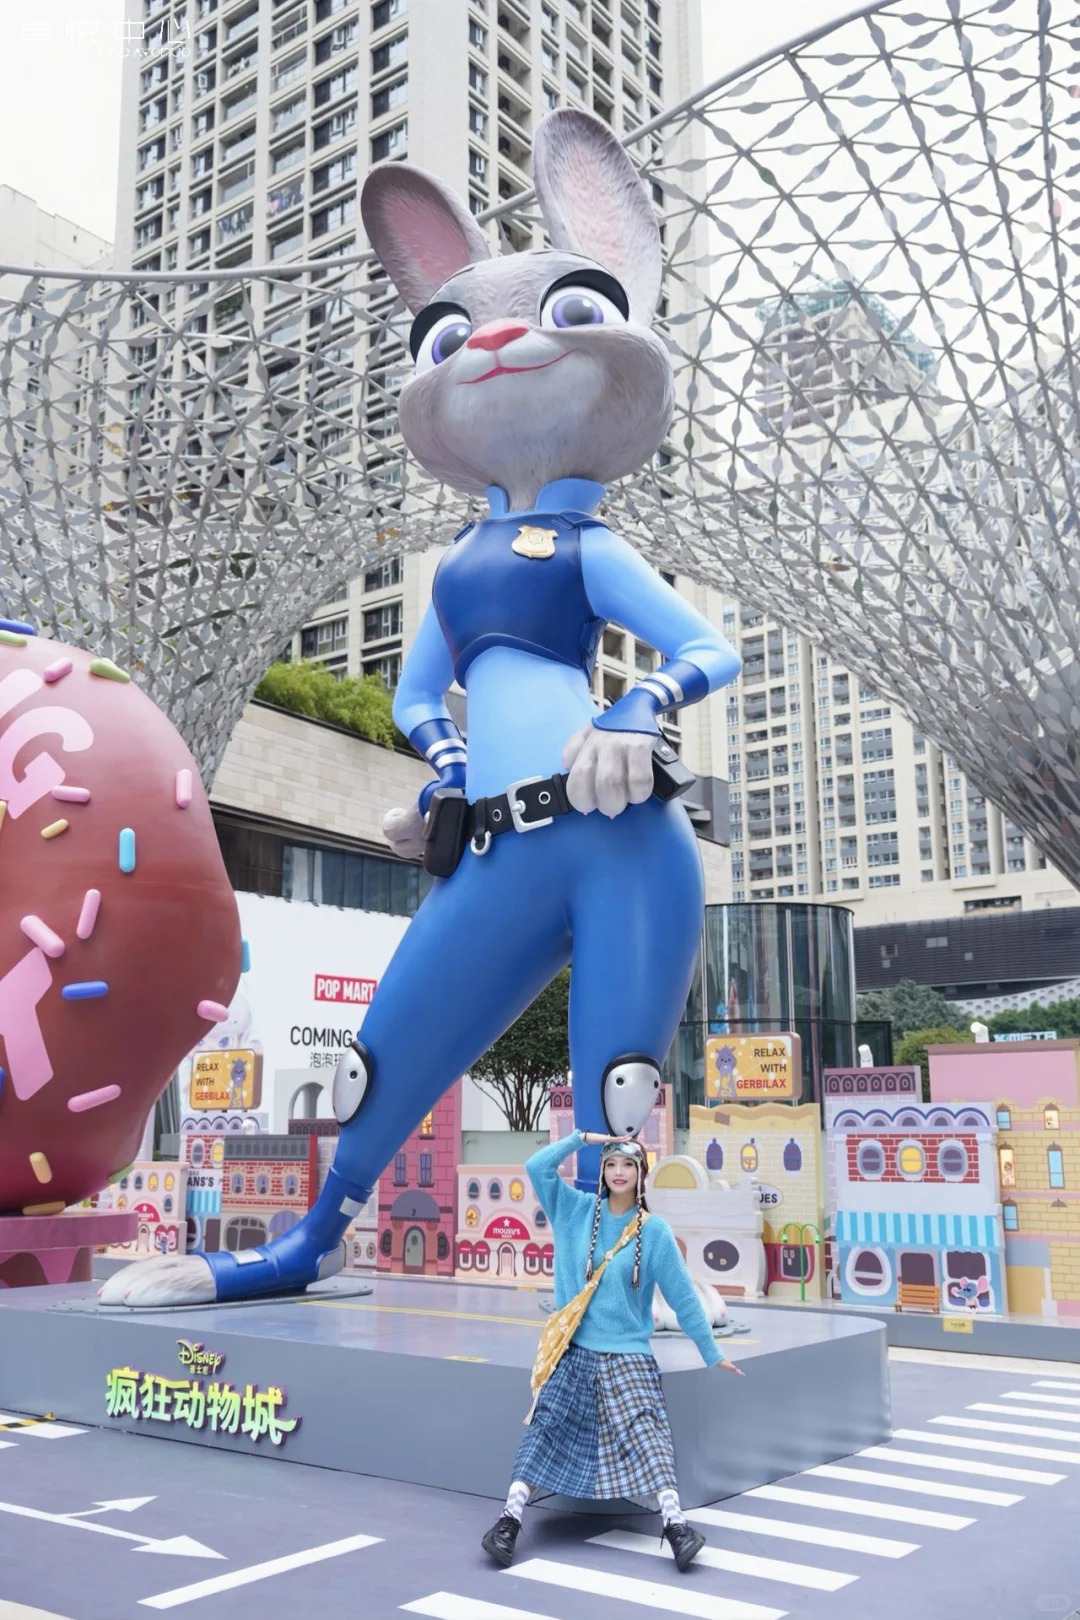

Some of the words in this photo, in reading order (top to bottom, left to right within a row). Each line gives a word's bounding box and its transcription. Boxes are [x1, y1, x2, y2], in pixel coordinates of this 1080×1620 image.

[316, 978, 341, 999] POP
[342, 980, 375, 1002] MART
[290, 1026, 353, 1048] COMING
[754, 1047, 786, 1057] RELAX
[196, 1062, 220, 1072] RELAX
[760, 1063, 787, 1073] WITH
[195, 1077, 215, 1086] WITH
[736, 1078, 787, 1089] GERBILAX
[194, 1091, 231, 1101] GERBILAX
[176, 1339, 223, 1375] Disney
[104, 1366, 299, 1446] 疯狂动物城
